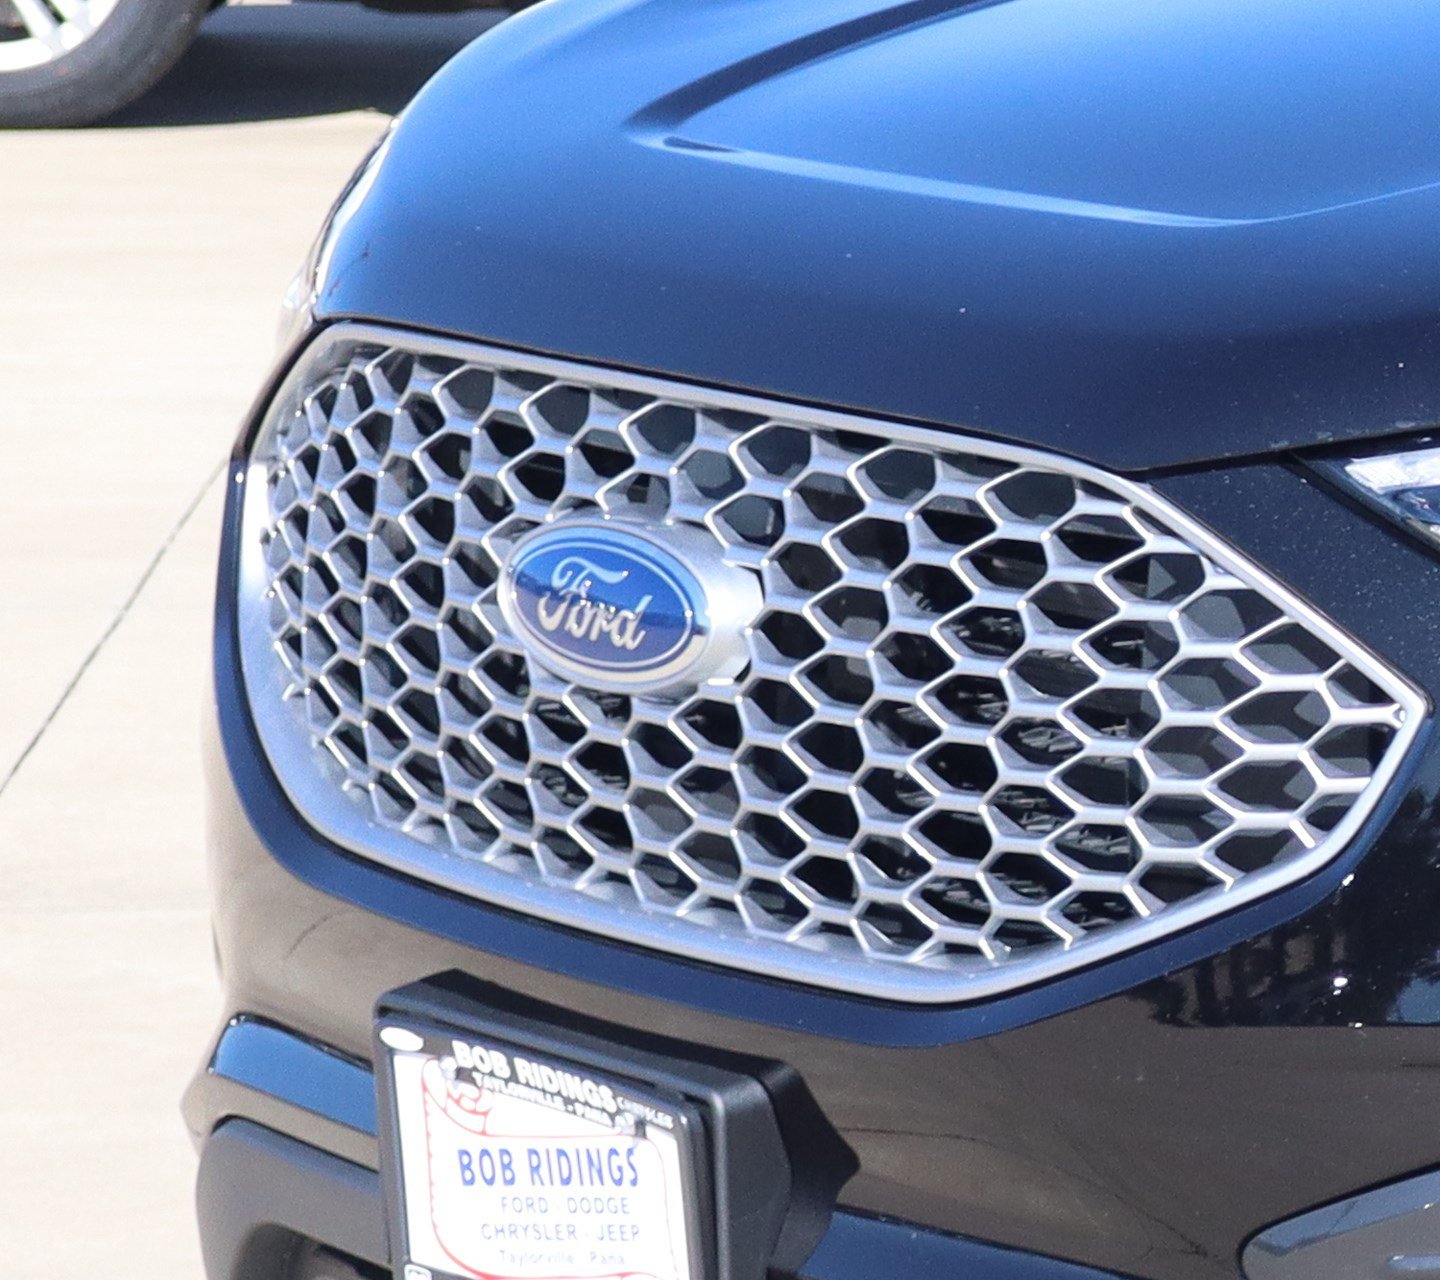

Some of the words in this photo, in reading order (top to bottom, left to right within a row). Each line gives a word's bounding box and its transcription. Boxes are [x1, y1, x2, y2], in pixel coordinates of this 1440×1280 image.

[538, 556, 653, 651] Ford
[452, 1040, 511, 1079] BOB
[513, 1057, 617, 1113] RIDINGS
[457, 1148, 516, 1187] BOB
[526, 1148, 639, 1188] RIDINGS
[500, 1196, 549, 1214] FORD
[567, 1197, 631, 1215] DODGE
[481, 1223, 578, 1241] CHRYSLER
[596, 1224, 640, 1242] JEEP
[499, 1249, 575, 1267] Taylorville
